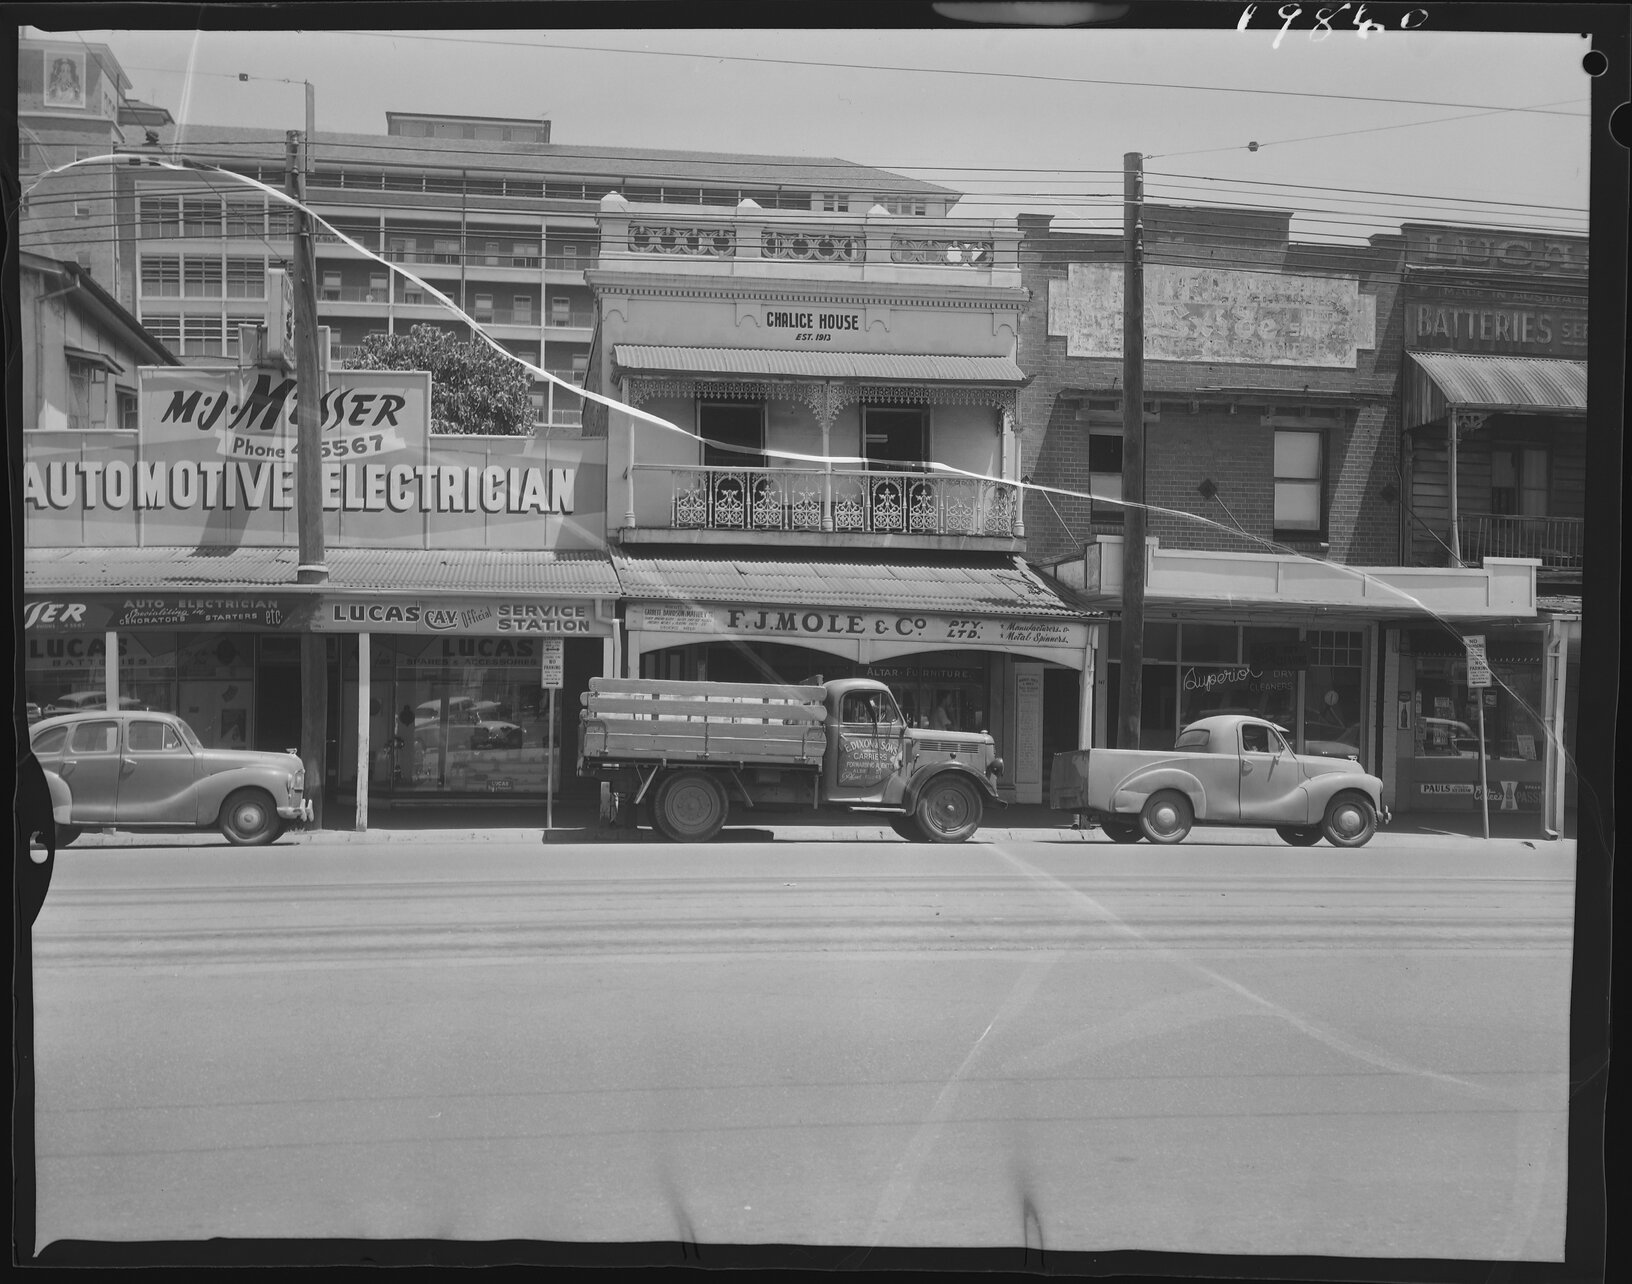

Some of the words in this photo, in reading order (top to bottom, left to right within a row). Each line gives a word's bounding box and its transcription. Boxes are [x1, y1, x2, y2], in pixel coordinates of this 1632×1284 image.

[1425, 234, 1588, 270] LUCA
[766, 311, 813, 329] CHALICE
[819, 313, 859, 331] HOUSE
[1417, 304, 1553, 344] BATTERIES
[795, 333, 813, 341] EST.
[815, 333, 831, 342] 1913
[232, 437, 285, 459] Phone
[24, 460, 296, 511] AUTOMOTIVE
[320, 463, 575, 515] ELECTRICIAN
[123, 599, 165, 609] AUTO
[178, 599, 279, 609] ELECTRICIAN
[205, 612, 258, 622] STARTERS
[333, 605, 421, 622] LUCAS
[460, 606, 492, 629] Official
[497, 604, 586, 619] SERVICE
[497, 618, 590, 633] STATION
[874, 619, 889, 635] &
[949, 620, 984, 630] PTY.
[946, 629, 981, 639] LTD.
[1006, 631, 1031, 641] Metal
[29, 636, 129, 659] LUCAS
[442, 638, 534, 657] LUCAS
[52, 657, 148, 667] BATTEIES
[406, 658, 449, 666] SPARES
[463, 658, 537, 666] ACCESSORIES
[866, 667, 898, 677] ALTAR
[1183, 666, 1264, 692] Superior
[1273, 669, 1295, 678] DRY
[1250, 681, 1294, 692] CLEANERS
[880, 741, 898, 756] SONS
[853, 752, 888, 761] CARRIERS
[1423, 784, 1451, 793] PAULS
